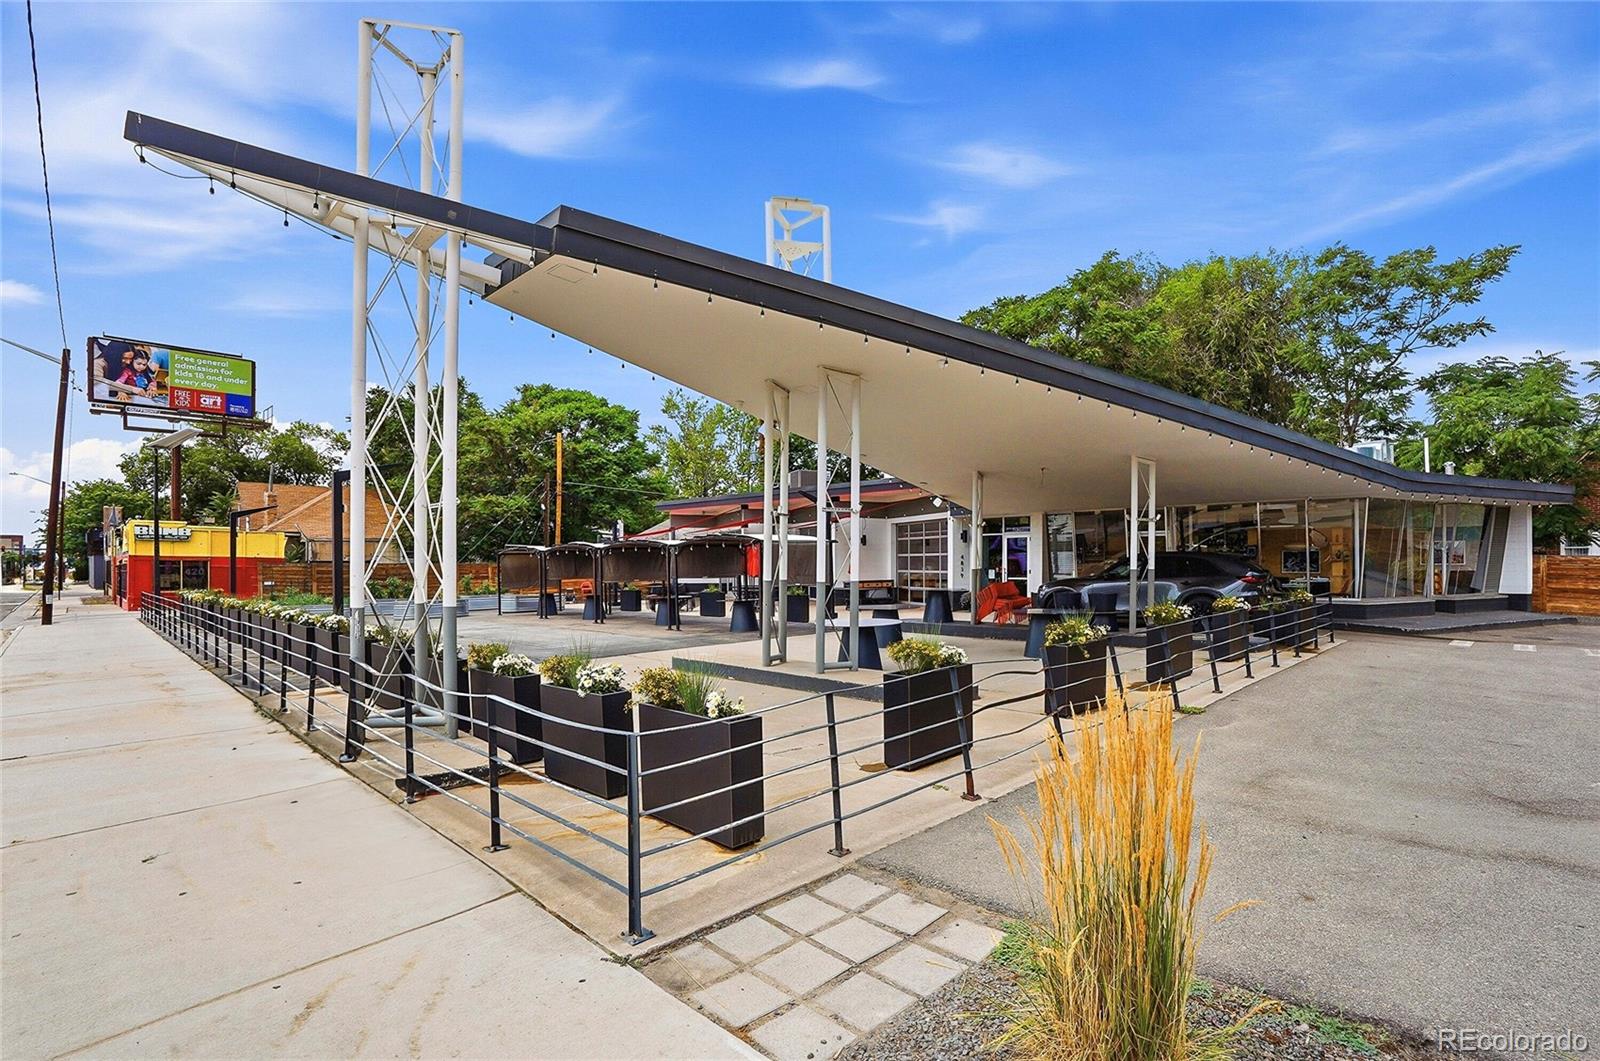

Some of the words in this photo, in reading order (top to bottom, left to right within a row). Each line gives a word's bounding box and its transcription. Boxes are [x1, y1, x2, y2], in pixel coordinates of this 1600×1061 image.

[175, 354, 194, 362] Free
[196, 358, 229, 368] general
[174, 363, 219, 374] admission
[175, 369, 193, 378] kids
[206, 374, 222, 382] and
[223, 377, 248, 385] under
[174, 379, 200, 388] every
[201, 381, 219, 389] day.
[200, 396, 222, 406] art
